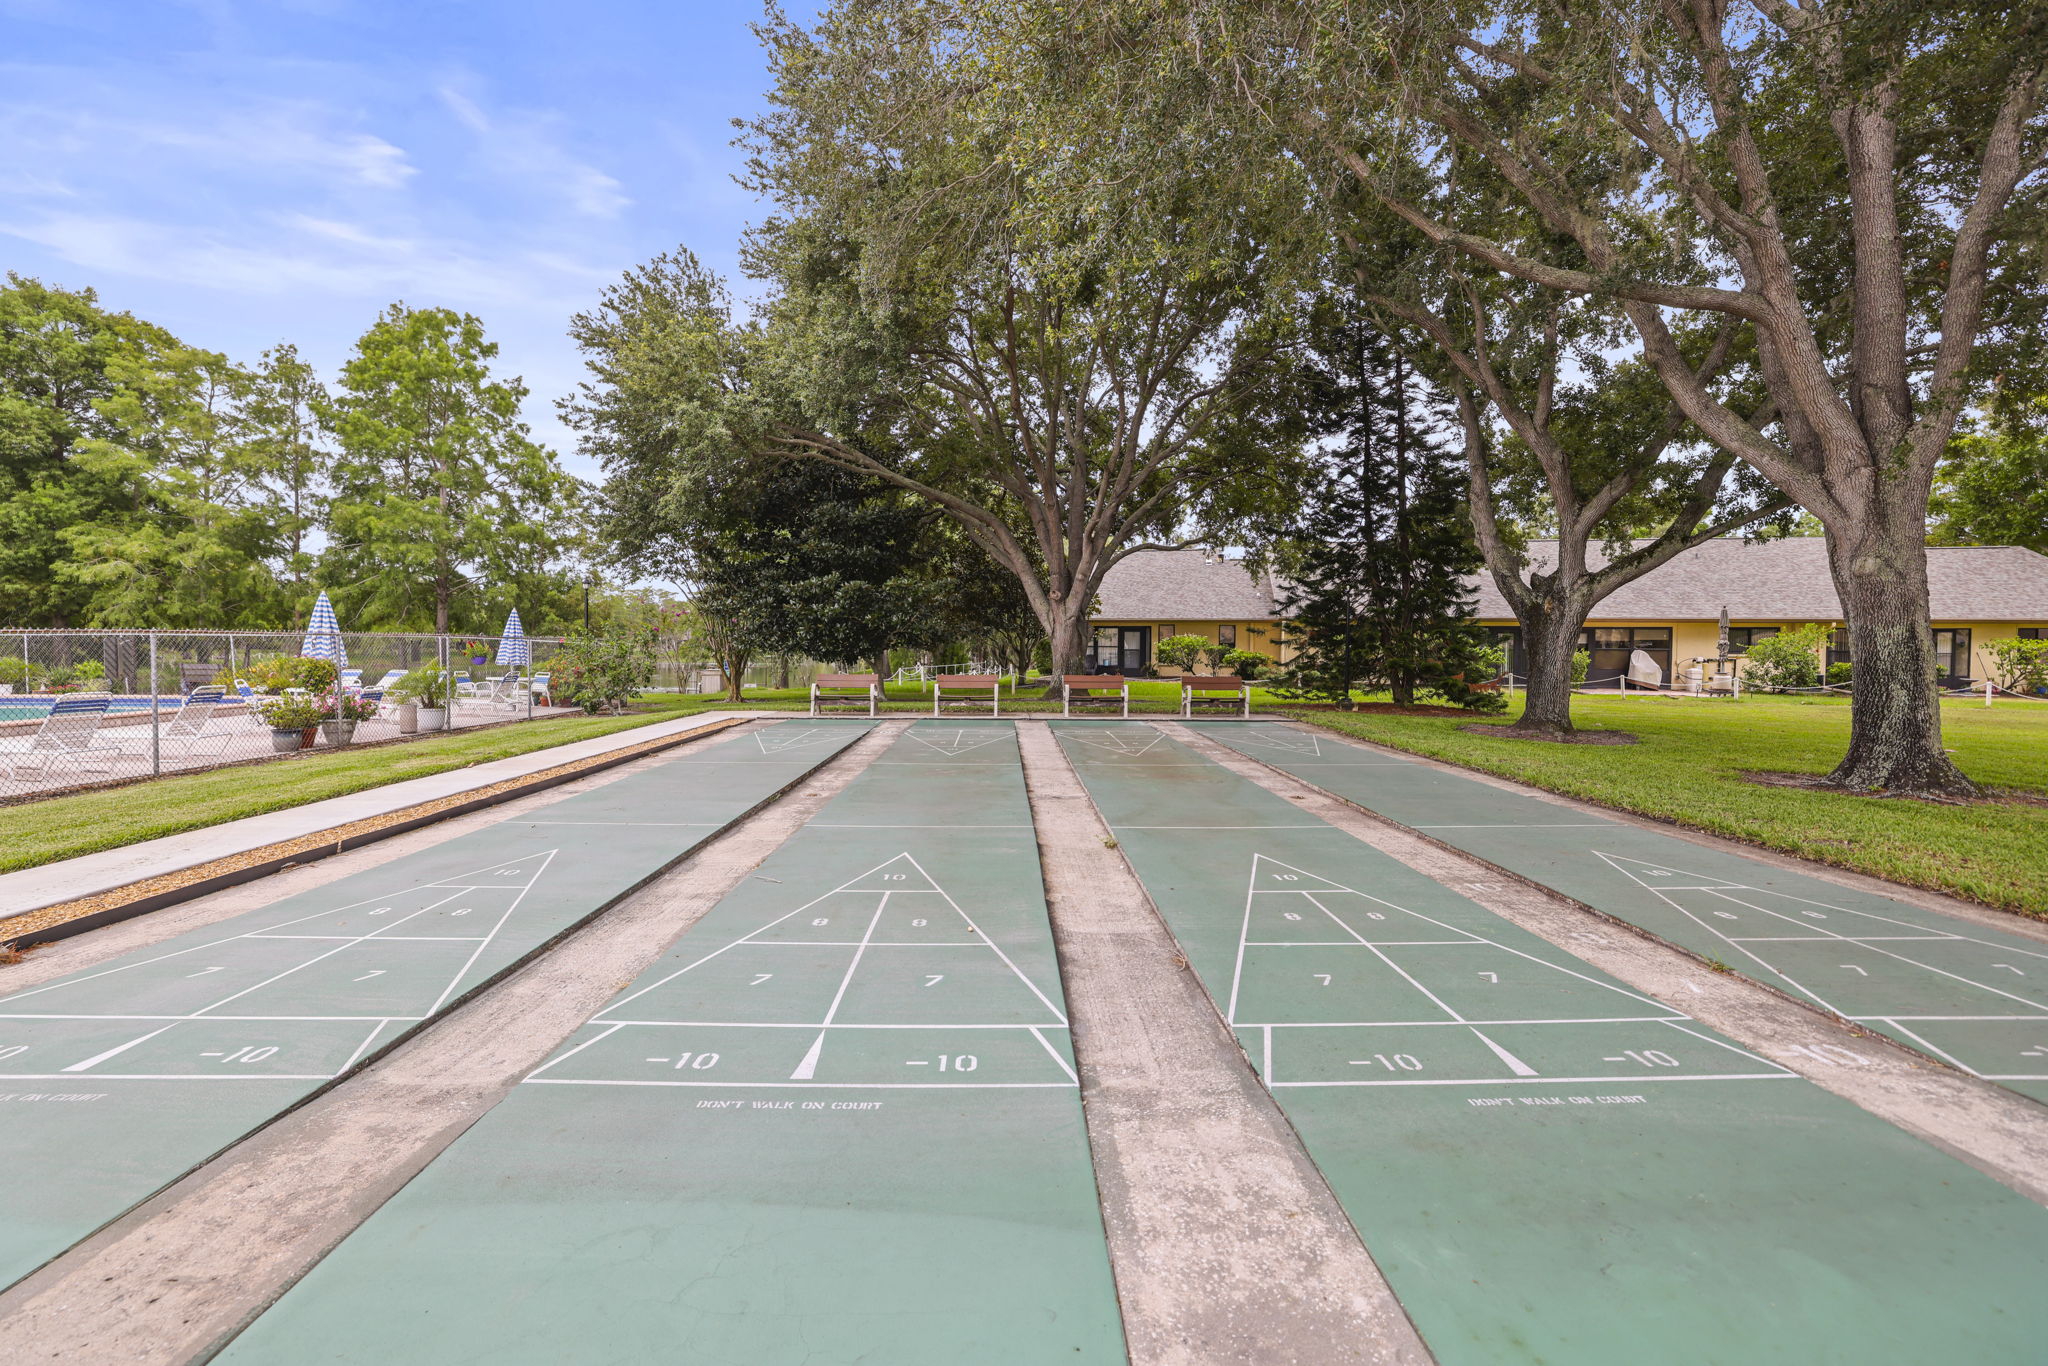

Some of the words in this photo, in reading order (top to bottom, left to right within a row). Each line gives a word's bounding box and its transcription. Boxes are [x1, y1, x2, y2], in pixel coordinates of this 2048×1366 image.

[495, 868, 519, 876] 10
[883, 873, 906, 881] 10
[1271, 874, 1299, 882] 10
[1641, 869, 1672, 877] 10
[368, 906, 392, 915] 8
[451, 908, 473, 916] 8
[1283, 912, 1302, 921] 8
[1366, 912, 1386, 921] 8
[811, 917, 829, 927] 8
[911, 918, 928, 927] 8
[186, 966, 225, 978] 7
[352, 969, 387, 982] 7
[1839, 964, 1868, 977] 7
[1991, 963, 2025, 976] 7
[749, 973, 773, 986] 7
[925, 975, 944, 987] 7
[1312, 974, 1332, 986] 7
[1478, 971, 1498, 984] 7
[199, 1045, 280, 1063] -10
[1601, 1049, 1681, 1068] -10
[645, 1051, 720, 1070] -10
[905, 1054, 978, 1072] -10
[1348, 1053, 1424, 1072] -10
[696, 1100, 745, 1109] DON'T
[752, 1101, 796, 1110] WALK
[801, 1102, 825, 1110] ON
[831, 1102, 884, 1110] COURT
[1467, 1097, 1514, 1106] DON'T
[1518, 1096, 1566, 1106] WALK
[1568, 1096, 1594, 1105] ON
[1596, 1095, 1648, 1104] COURT
